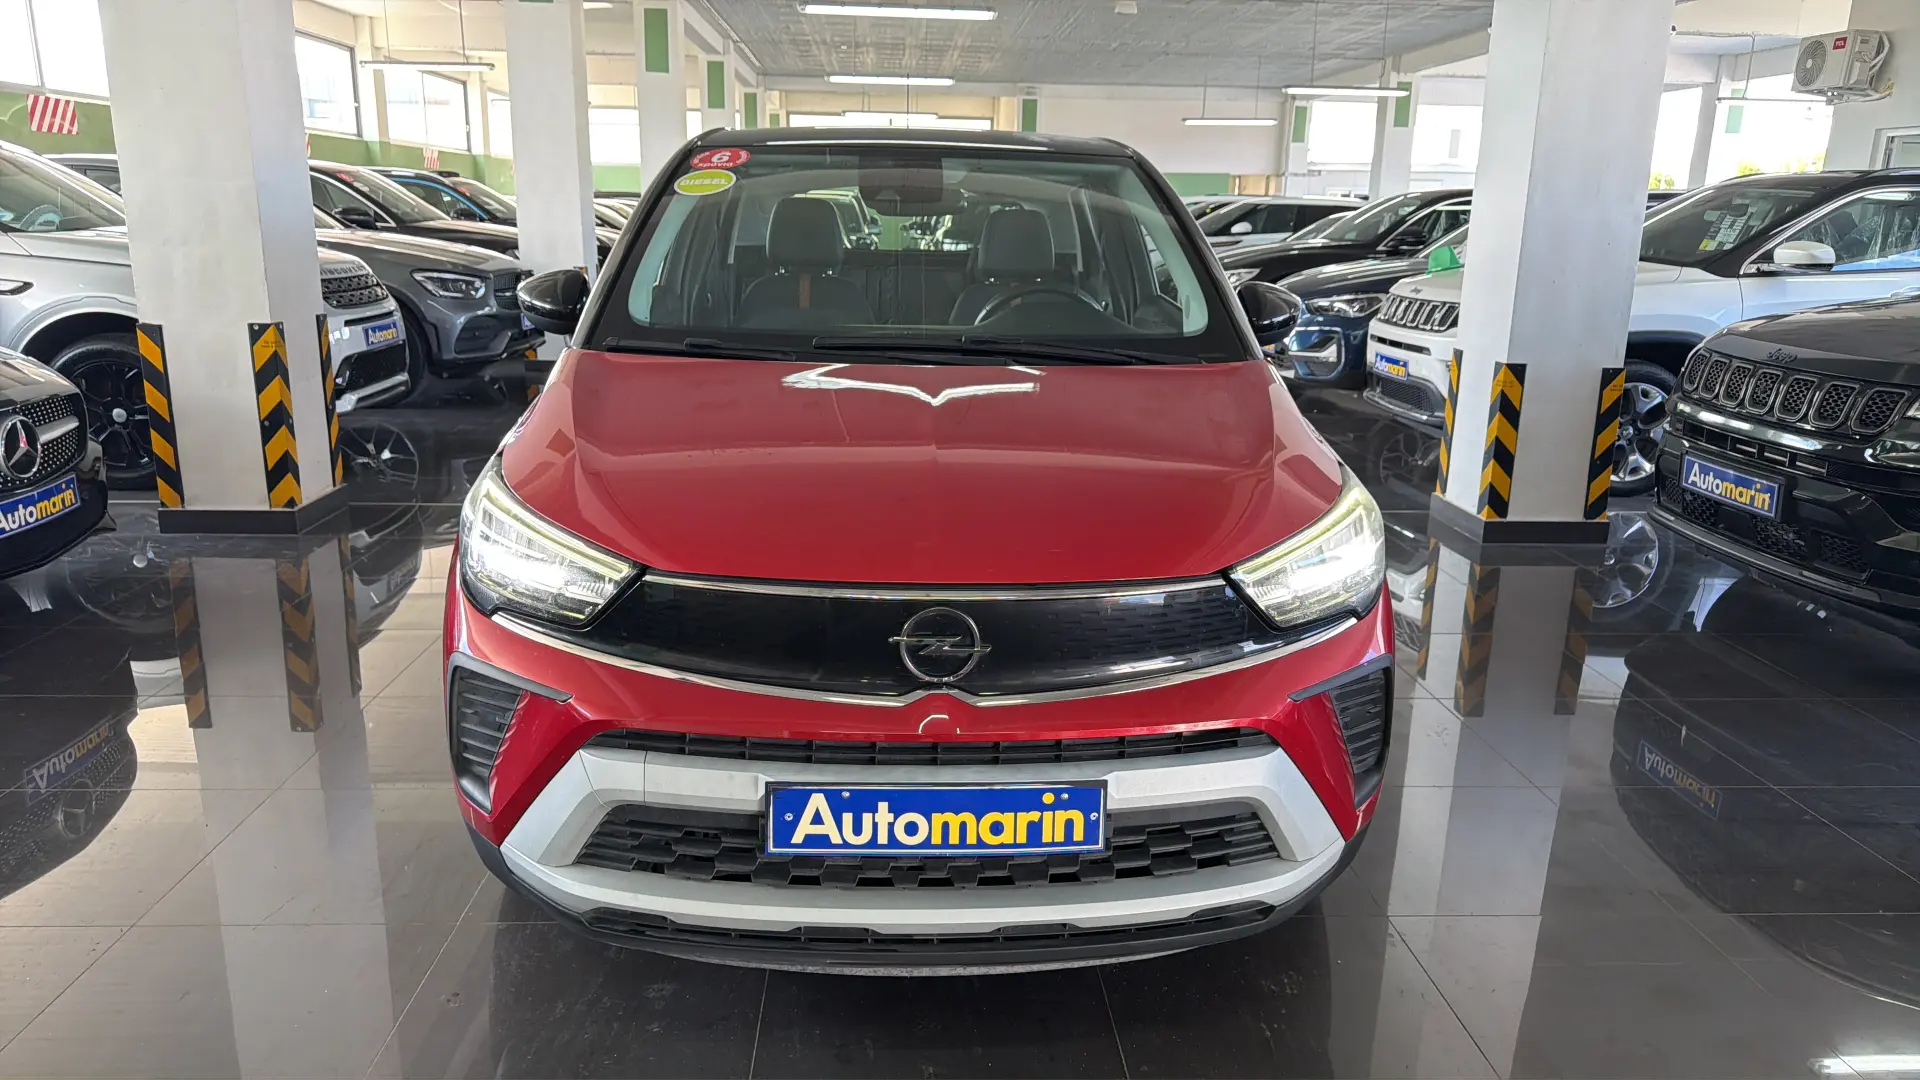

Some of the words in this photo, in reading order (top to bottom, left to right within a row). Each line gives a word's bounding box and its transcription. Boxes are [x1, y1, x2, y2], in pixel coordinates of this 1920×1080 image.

[711, 151, 732, 163] 6
[679, 178, 728, 186] DIESEL
[1375, 354, 1407, 378] Automarin
[1687, 462, 1771, 511] Automarin
[789, 792, 1085, 846] Automarin
